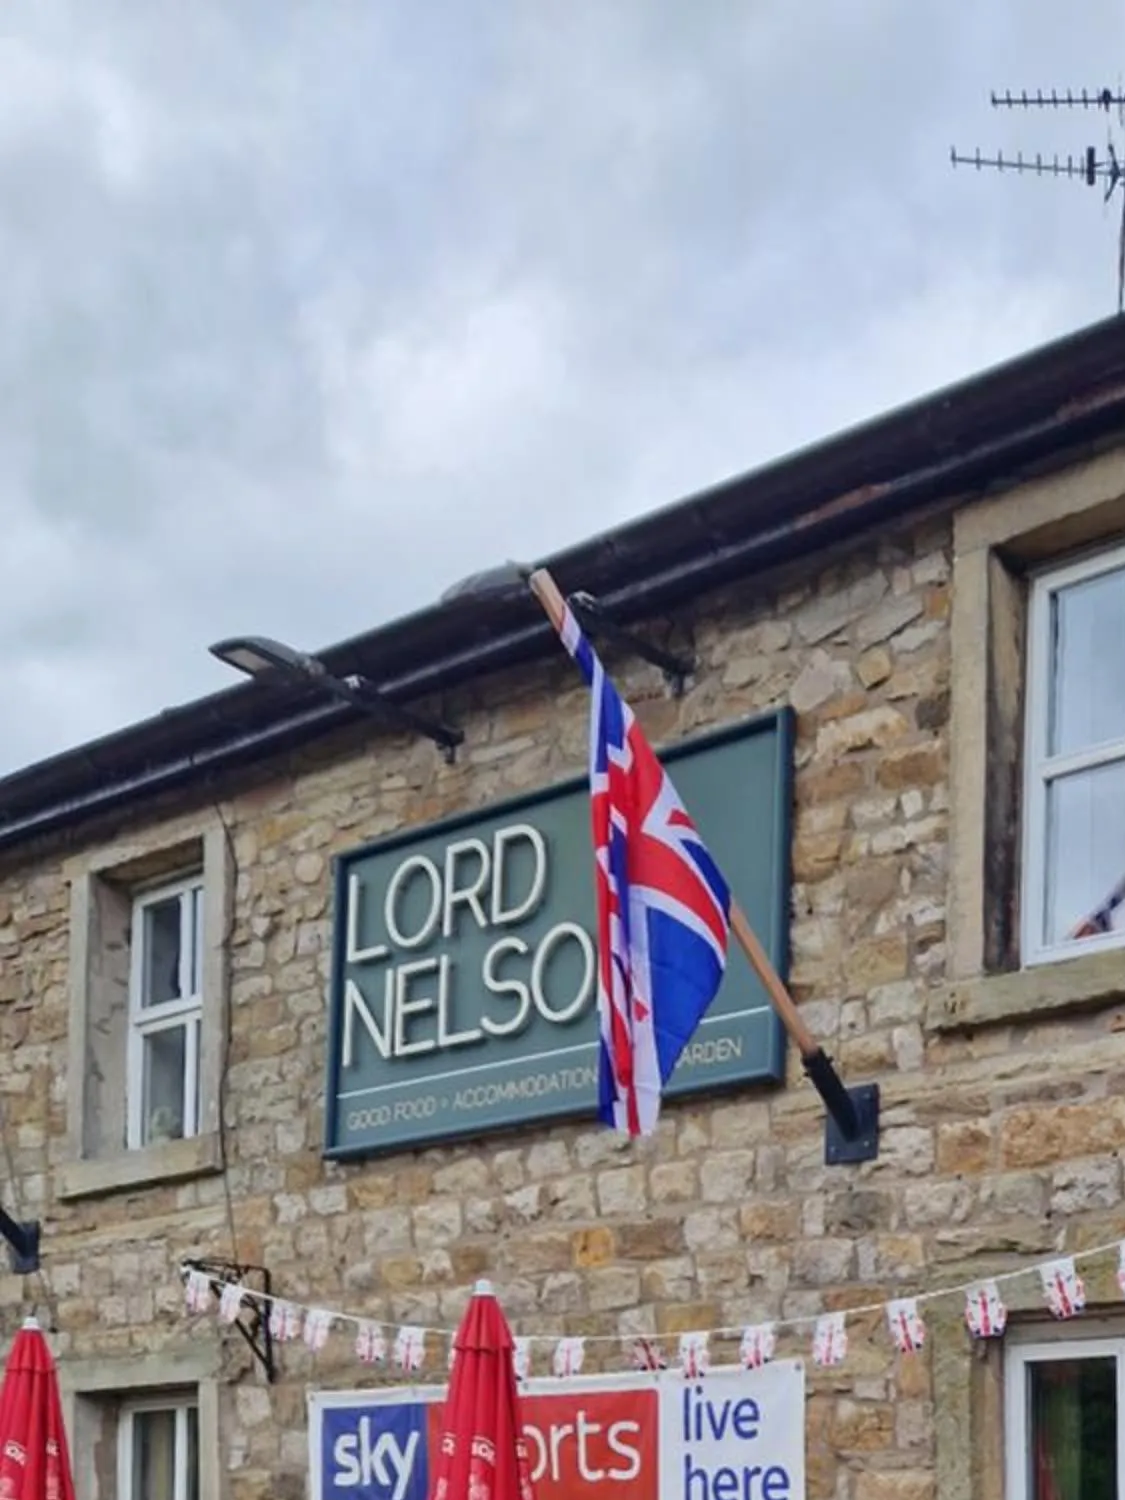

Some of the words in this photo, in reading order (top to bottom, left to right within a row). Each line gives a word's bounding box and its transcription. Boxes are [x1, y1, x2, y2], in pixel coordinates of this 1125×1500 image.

[347, 823, 548, 963] LORD
[342, 922, 602, 1067] NELSO
[347, 1106, 391, 1131] GOOD
[394, 1096, 437, 1121] FOOD
[676, 1036, 743, 1068] ARDEN
[682, 1385, 761, 1442] live
